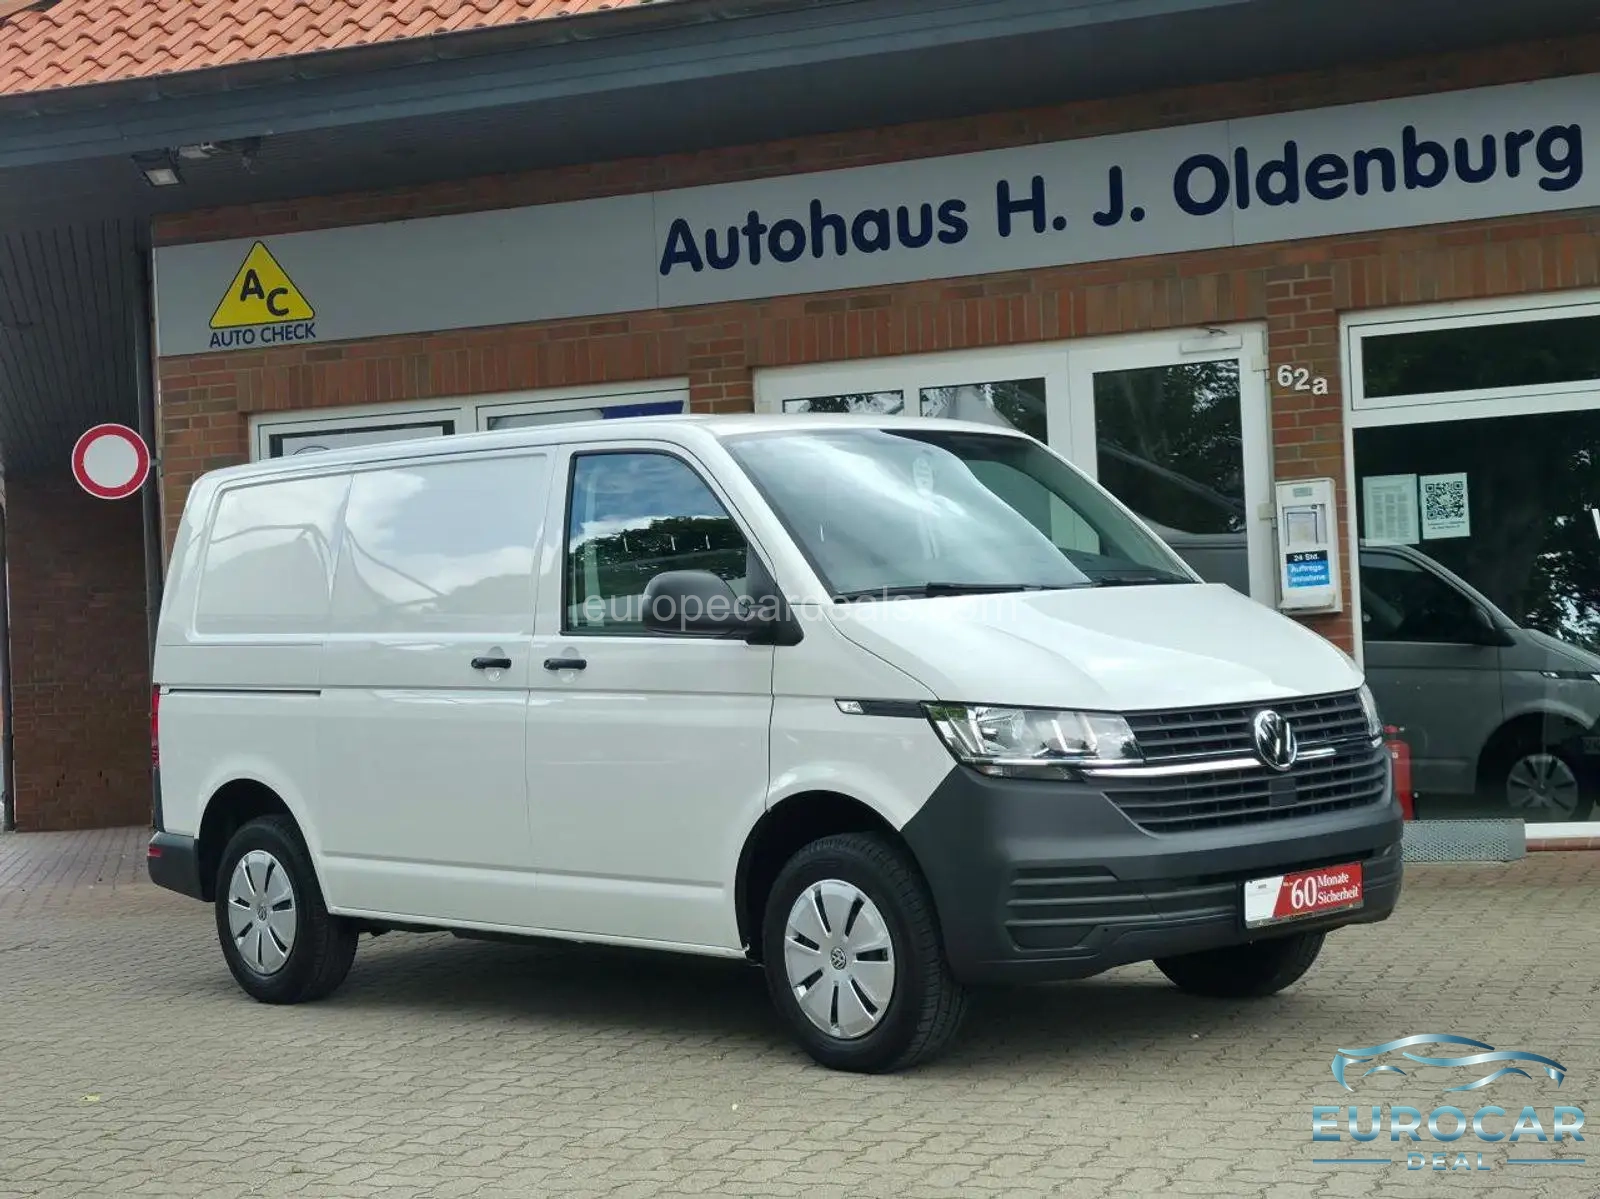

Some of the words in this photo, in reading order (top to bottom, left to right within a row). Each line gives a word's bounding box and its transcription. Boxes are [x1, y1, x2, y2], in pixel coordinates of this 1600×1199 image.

[659, 198, 969, 276] Autohaus
[996, 175, 1067, 238] H.
[1092, 165, 1145, 227] J.
[1173, 123, 1583, 216] Oldenburg
[209, 328, 256, 348] AUTO
[260, 321, 317, 343] CHECK
[1277, 364, 1329, 395] 62a
[1291, 876, 1318, 910] 60
[1317, 872, 1350, 888] Monate
